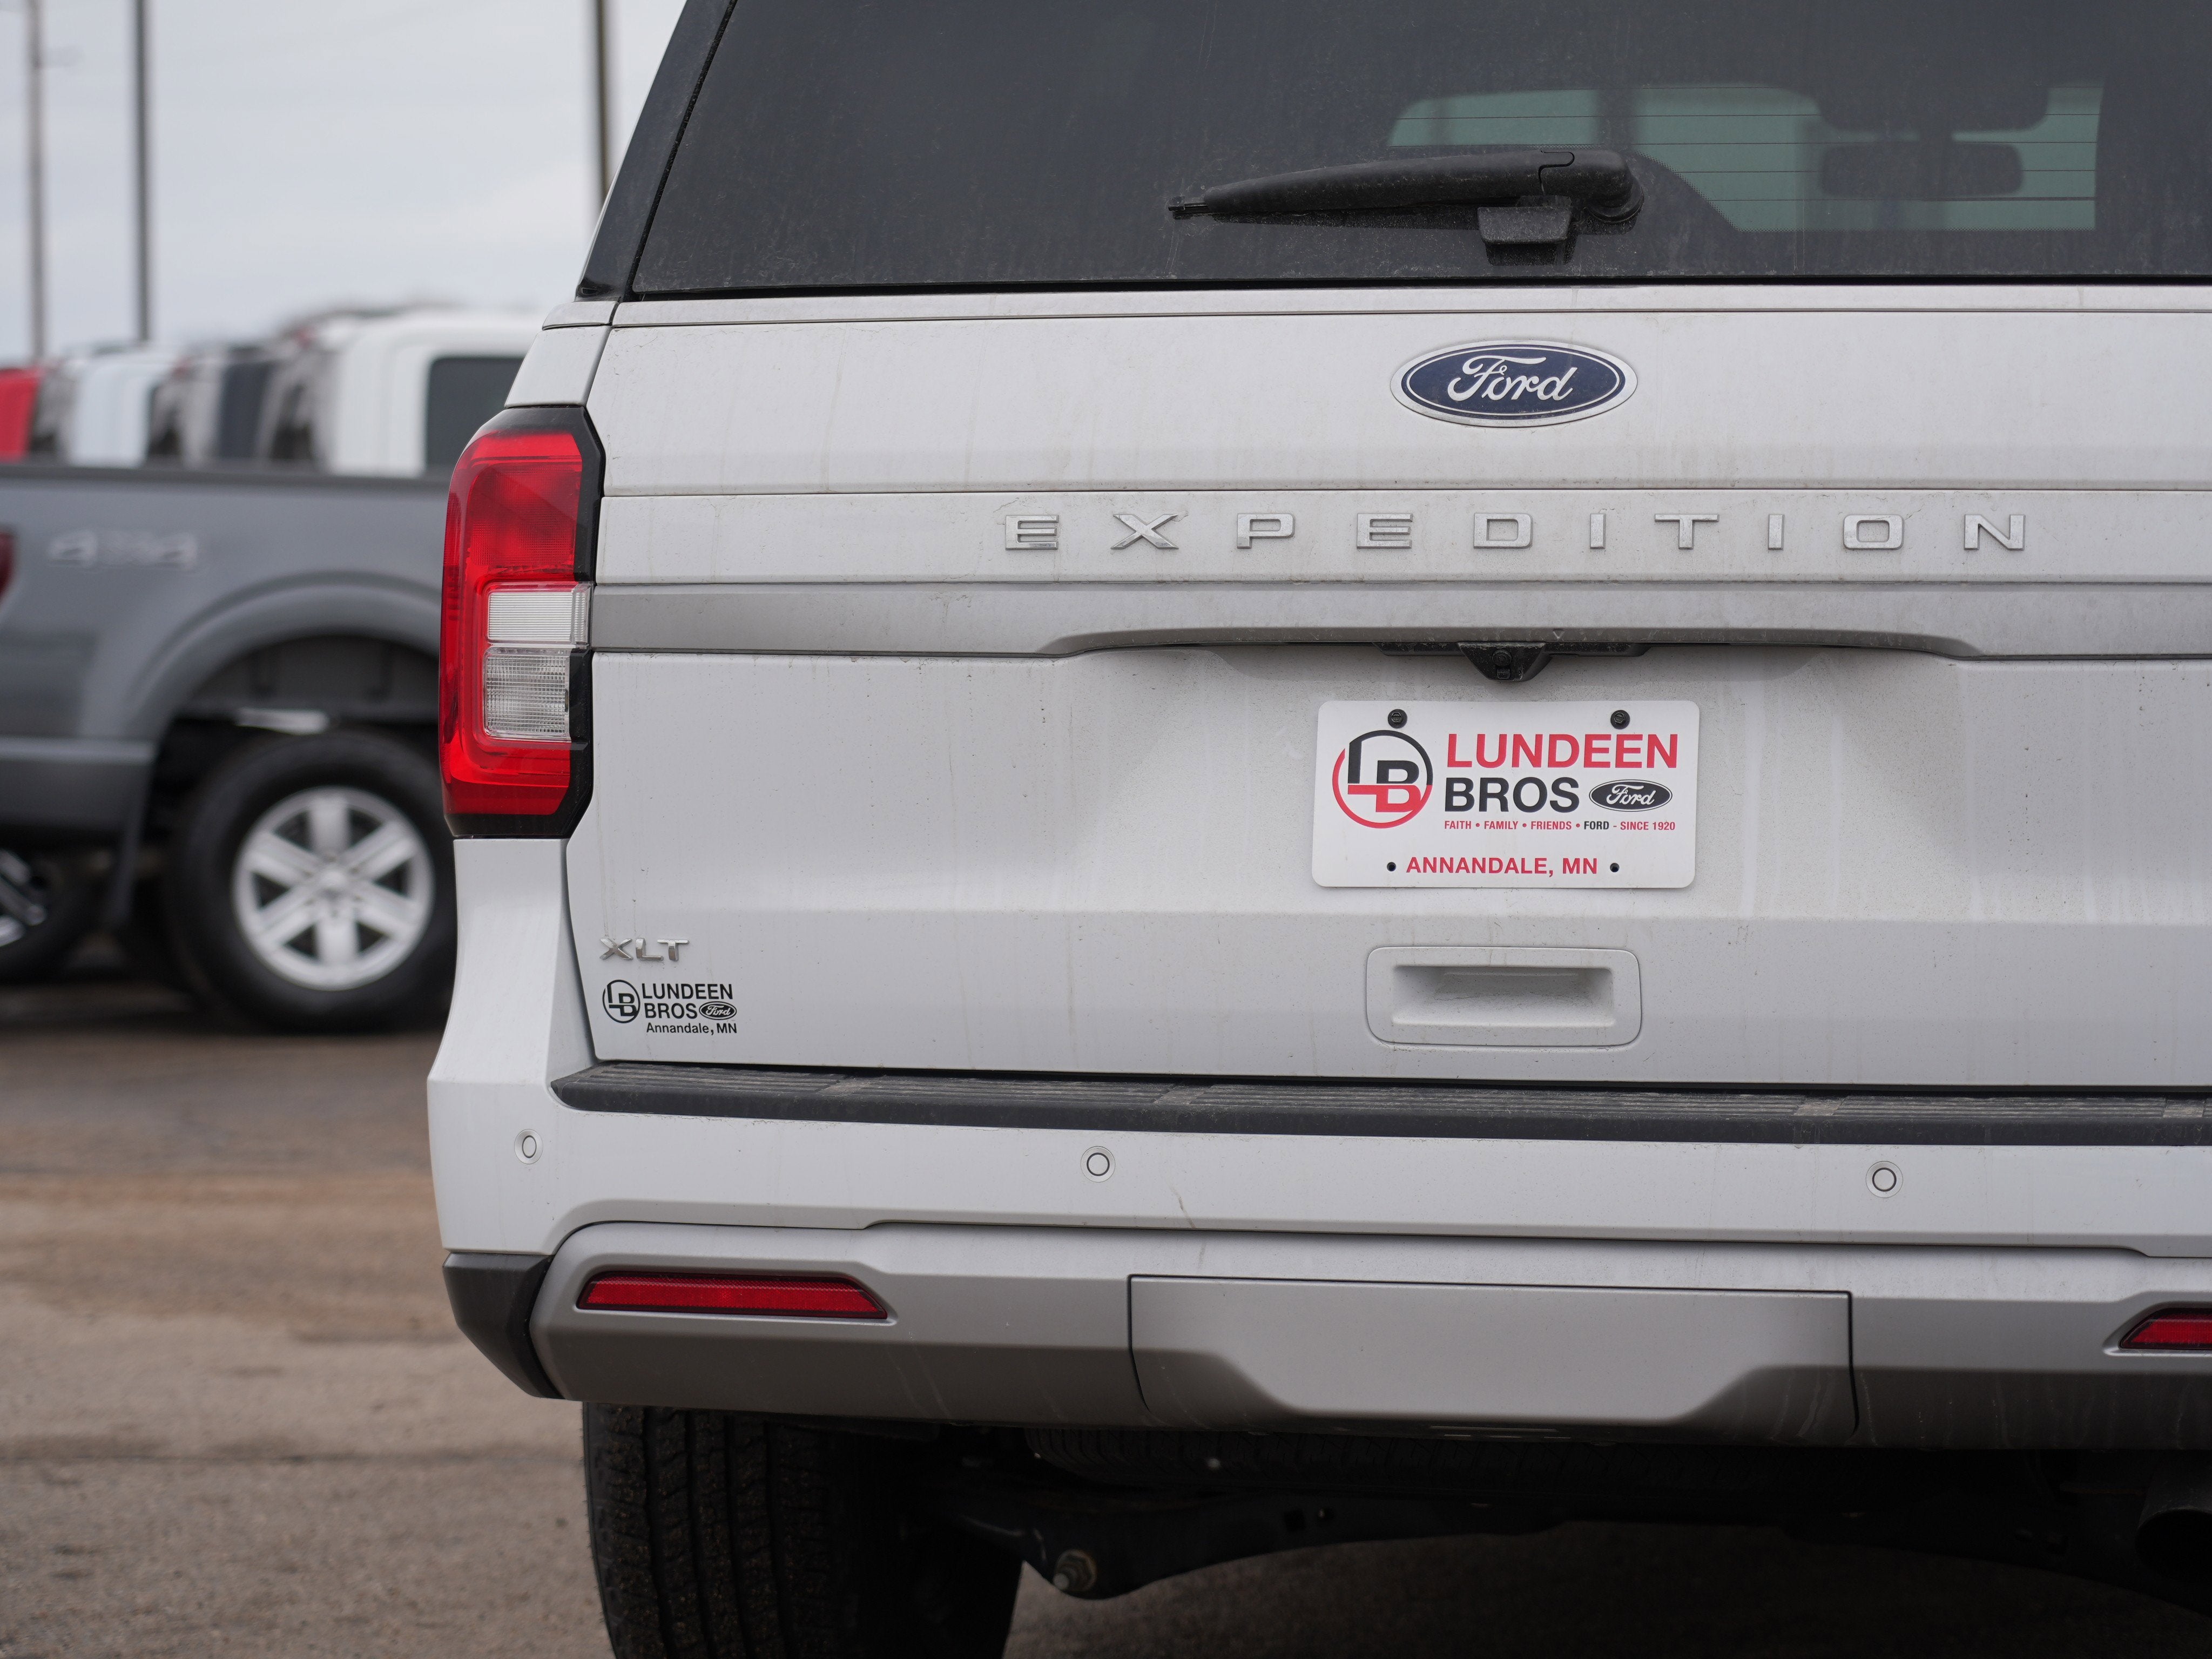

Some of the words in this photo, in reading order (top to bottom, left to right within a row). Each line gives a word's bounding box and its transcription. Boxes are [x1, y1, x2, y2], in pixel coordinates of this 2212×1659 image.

[1447, 355, 1578, 401] Ford
[1004, 513, 2026, 551] EXPEDITION
[1447, 733, 1678, 768] LUNDEEN
[1445, 777, 1579, 812] BROS
[1606, 785, 1655, 806] Ford
[1444, 820, 1472, 830] FAITH
[1483, 820, 1519, 830] FAMILY
[1530, 821, 1572, 830] FRIENDS
[1583, 821, 1609, 830] FORD
[1620, 821, 1649, 831] SINCE
[1652, 821, 1676, 831] 1920
[1406, 857, 1554, 878] ANNANDALE,
[1562, 858, 1597, 874] MN
[599, 938, 690, 961] XLT
[642, 983, 733, 1000] LUNDEEN
[644, 1003, 698, 1019] BROS
[705, 1006, 731, 1016] Ford
[646, 1022, 714, 1035] Annandale,
[717, 1023, 737, 1034] MN
